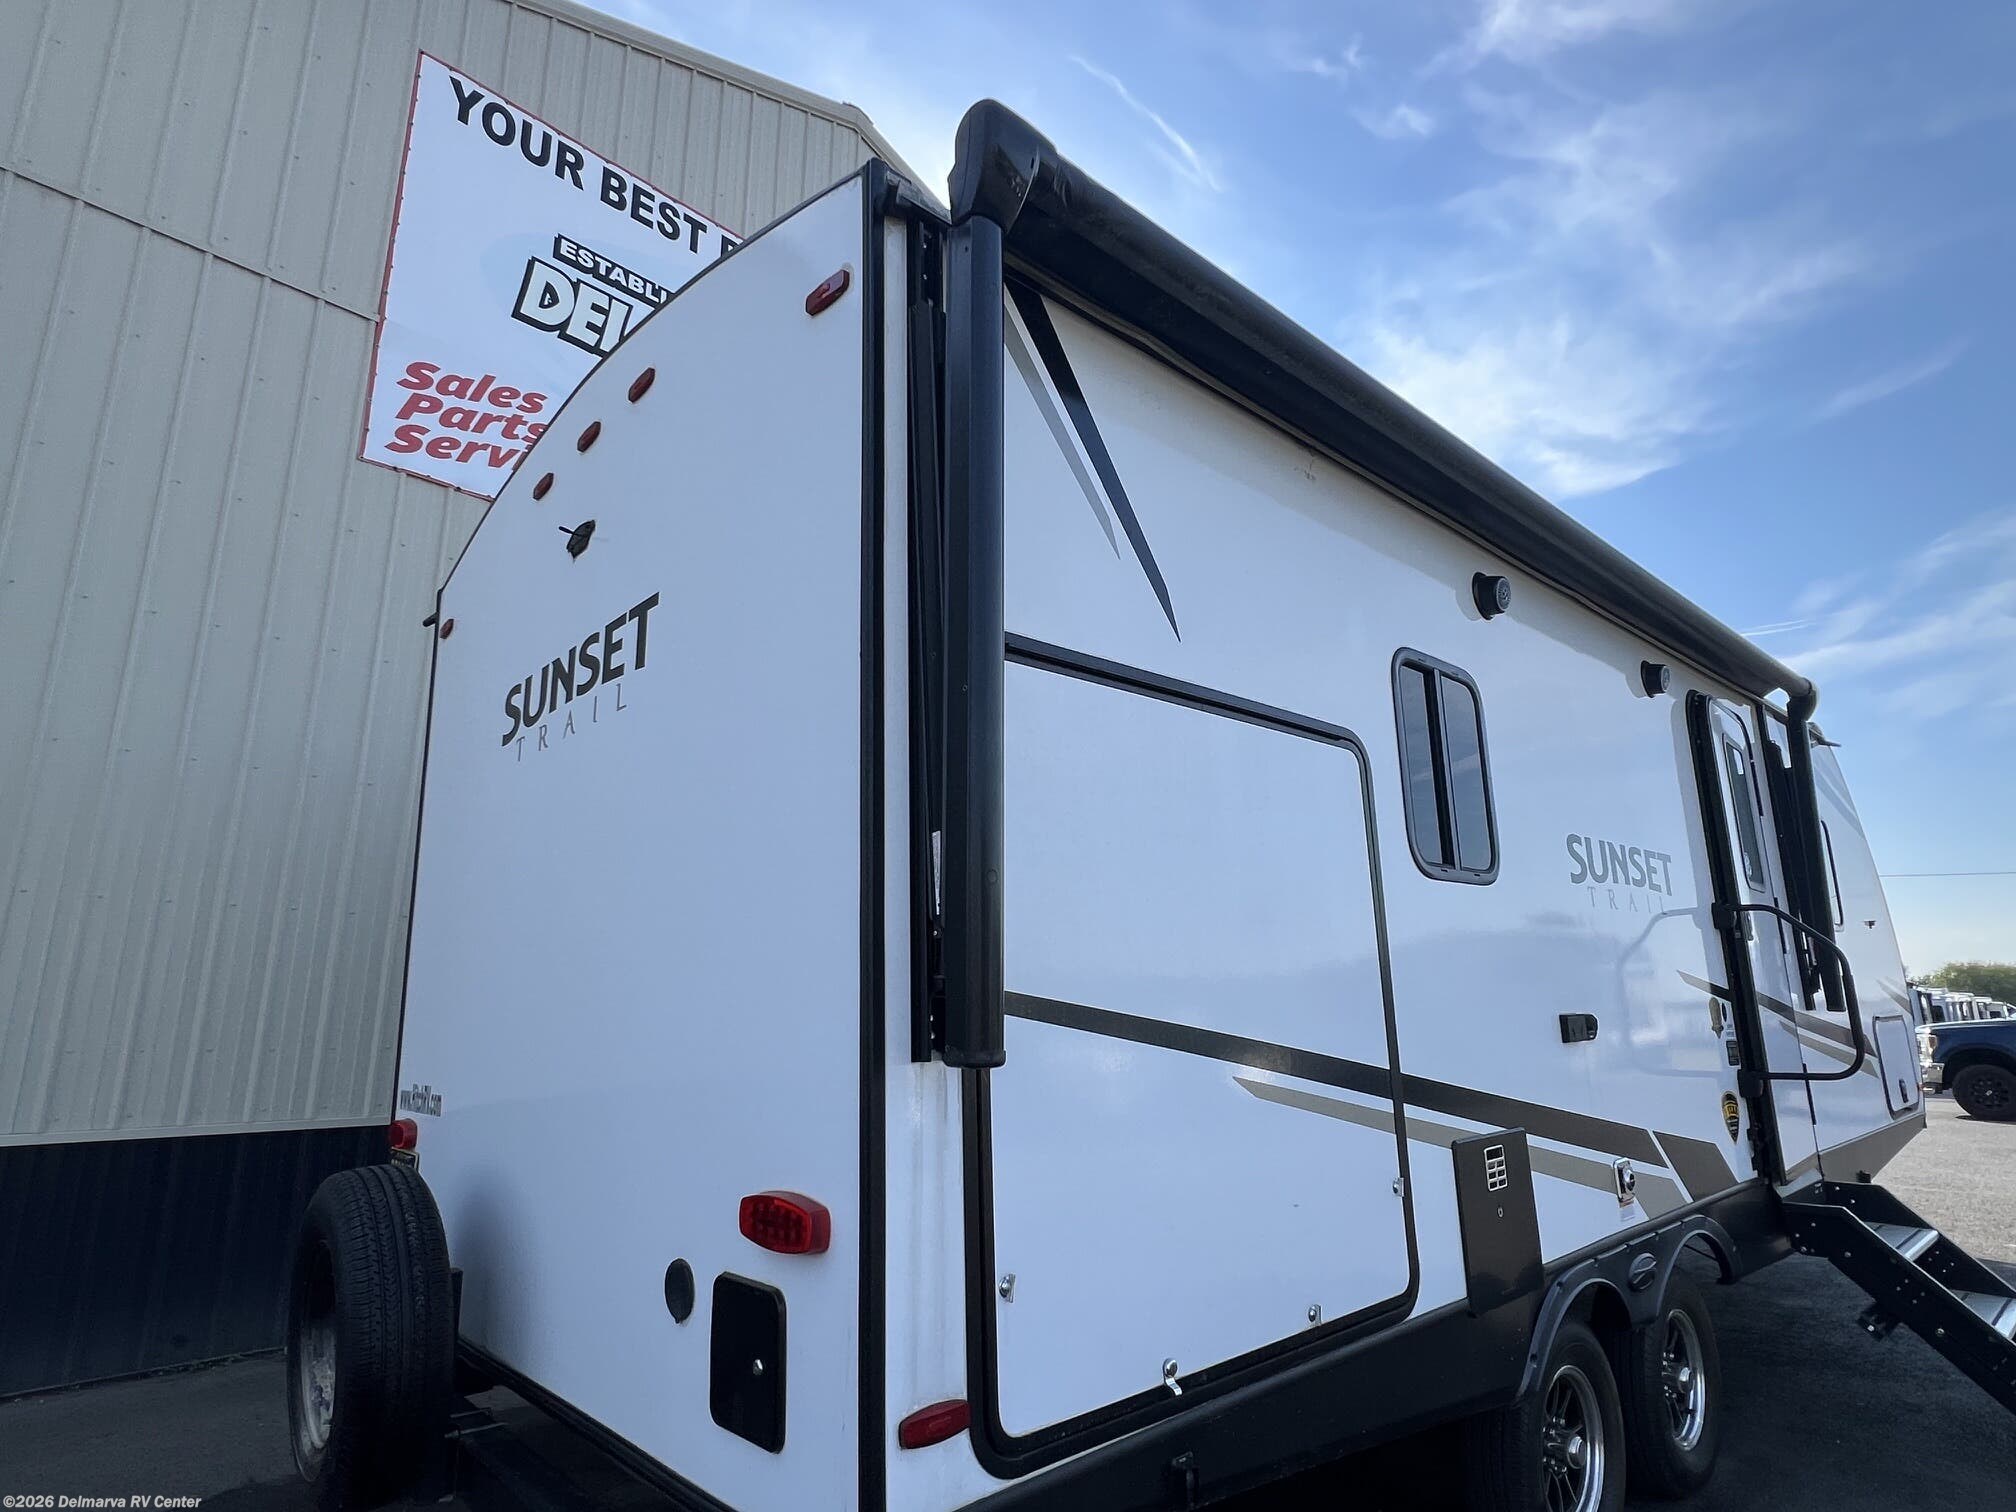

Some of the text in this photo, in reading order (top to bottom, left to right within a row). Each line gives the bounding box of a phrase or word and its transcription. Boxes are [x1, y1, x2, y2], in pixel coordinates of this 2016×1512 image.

[449, 75, 707, 254] YOUR BEST
[395, 392, 549, 443] Parts
[396, 362, 549, 414] Sales
[502, 591, 660, 747] SUNSET
[516, 683, 627, 762] TRAIL
[1566, 833, 1673, 896] SUNSET
[1587, 886, 1667, 915] TRAIL
